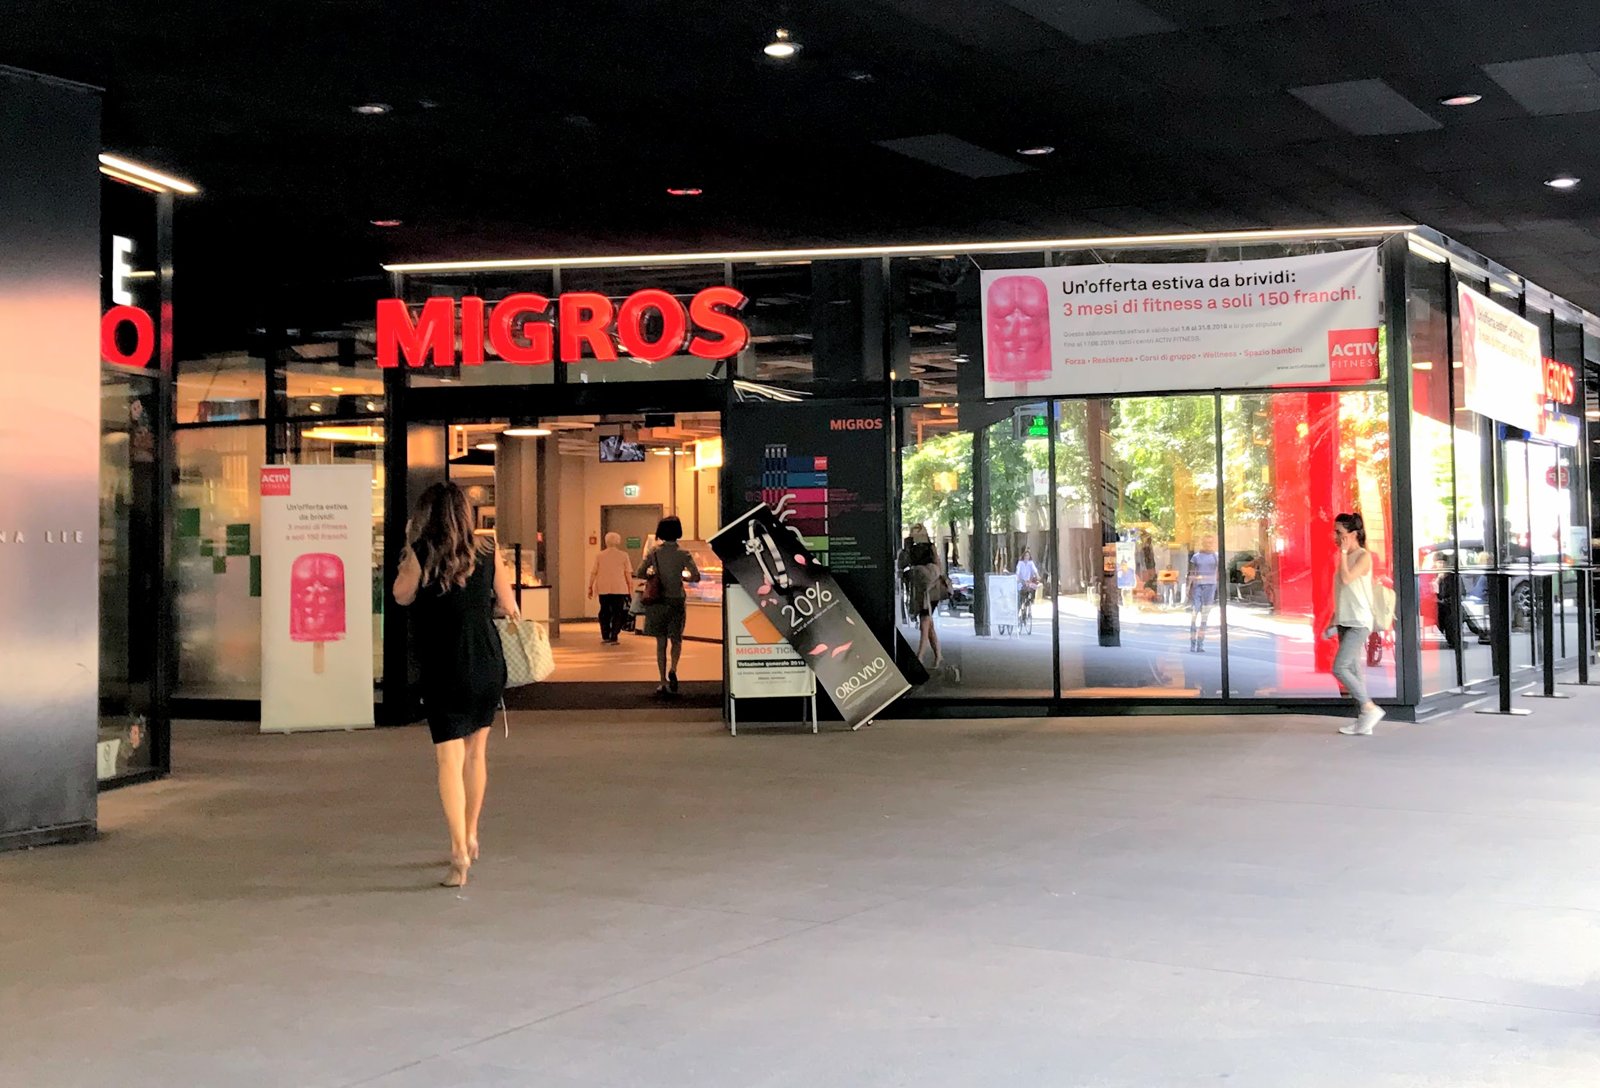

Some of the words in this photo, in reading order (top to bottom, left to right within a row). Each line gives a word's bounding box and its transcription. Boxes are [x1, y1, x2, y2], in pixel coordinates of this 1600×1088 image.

[1062, 278, 1147, 294] Un'offerta
[1152, 276, 1204, 290] estiva
[1208, 274, 1230, 288] da
[1235, 270, 1296, 287] brividi:
[1063, 302, 1073, 317] 3
[1077, 300, 1118, 316] mesi
[1122, 299, 1138, 313] di
[1142, 297, 1203, 312] fitness
[1207, 298, 1217, 310] a
[1222, 293, 1252, 308] soli
[1258, 291, 1289, 306] 150
[1293, 285, 1361, 304] franchi.
[376, 286, 750, 368] MIGROS
[1092, 356, 1134, 364] Resistenza
[1169, 353, 1197, 362] gruppo
[1203, 350, 1237, 359] Wellness
[1243, 348, 1270, 358] Spazio
[1271, 346, 1303, 355] bambini
[1331, 342, 1378, 357] ACTIV
[830, 418, 883, 431] MIGROS
[261, 474, 289, 483] ACTIV
[45, 530, 82, 544] LIE
[781, 581, 832, 627] 20%
[736, 647, 772, 655] MIGROS
[835, 676, 860, 699] ORO
[857, 657, 885, 681] VIVO
